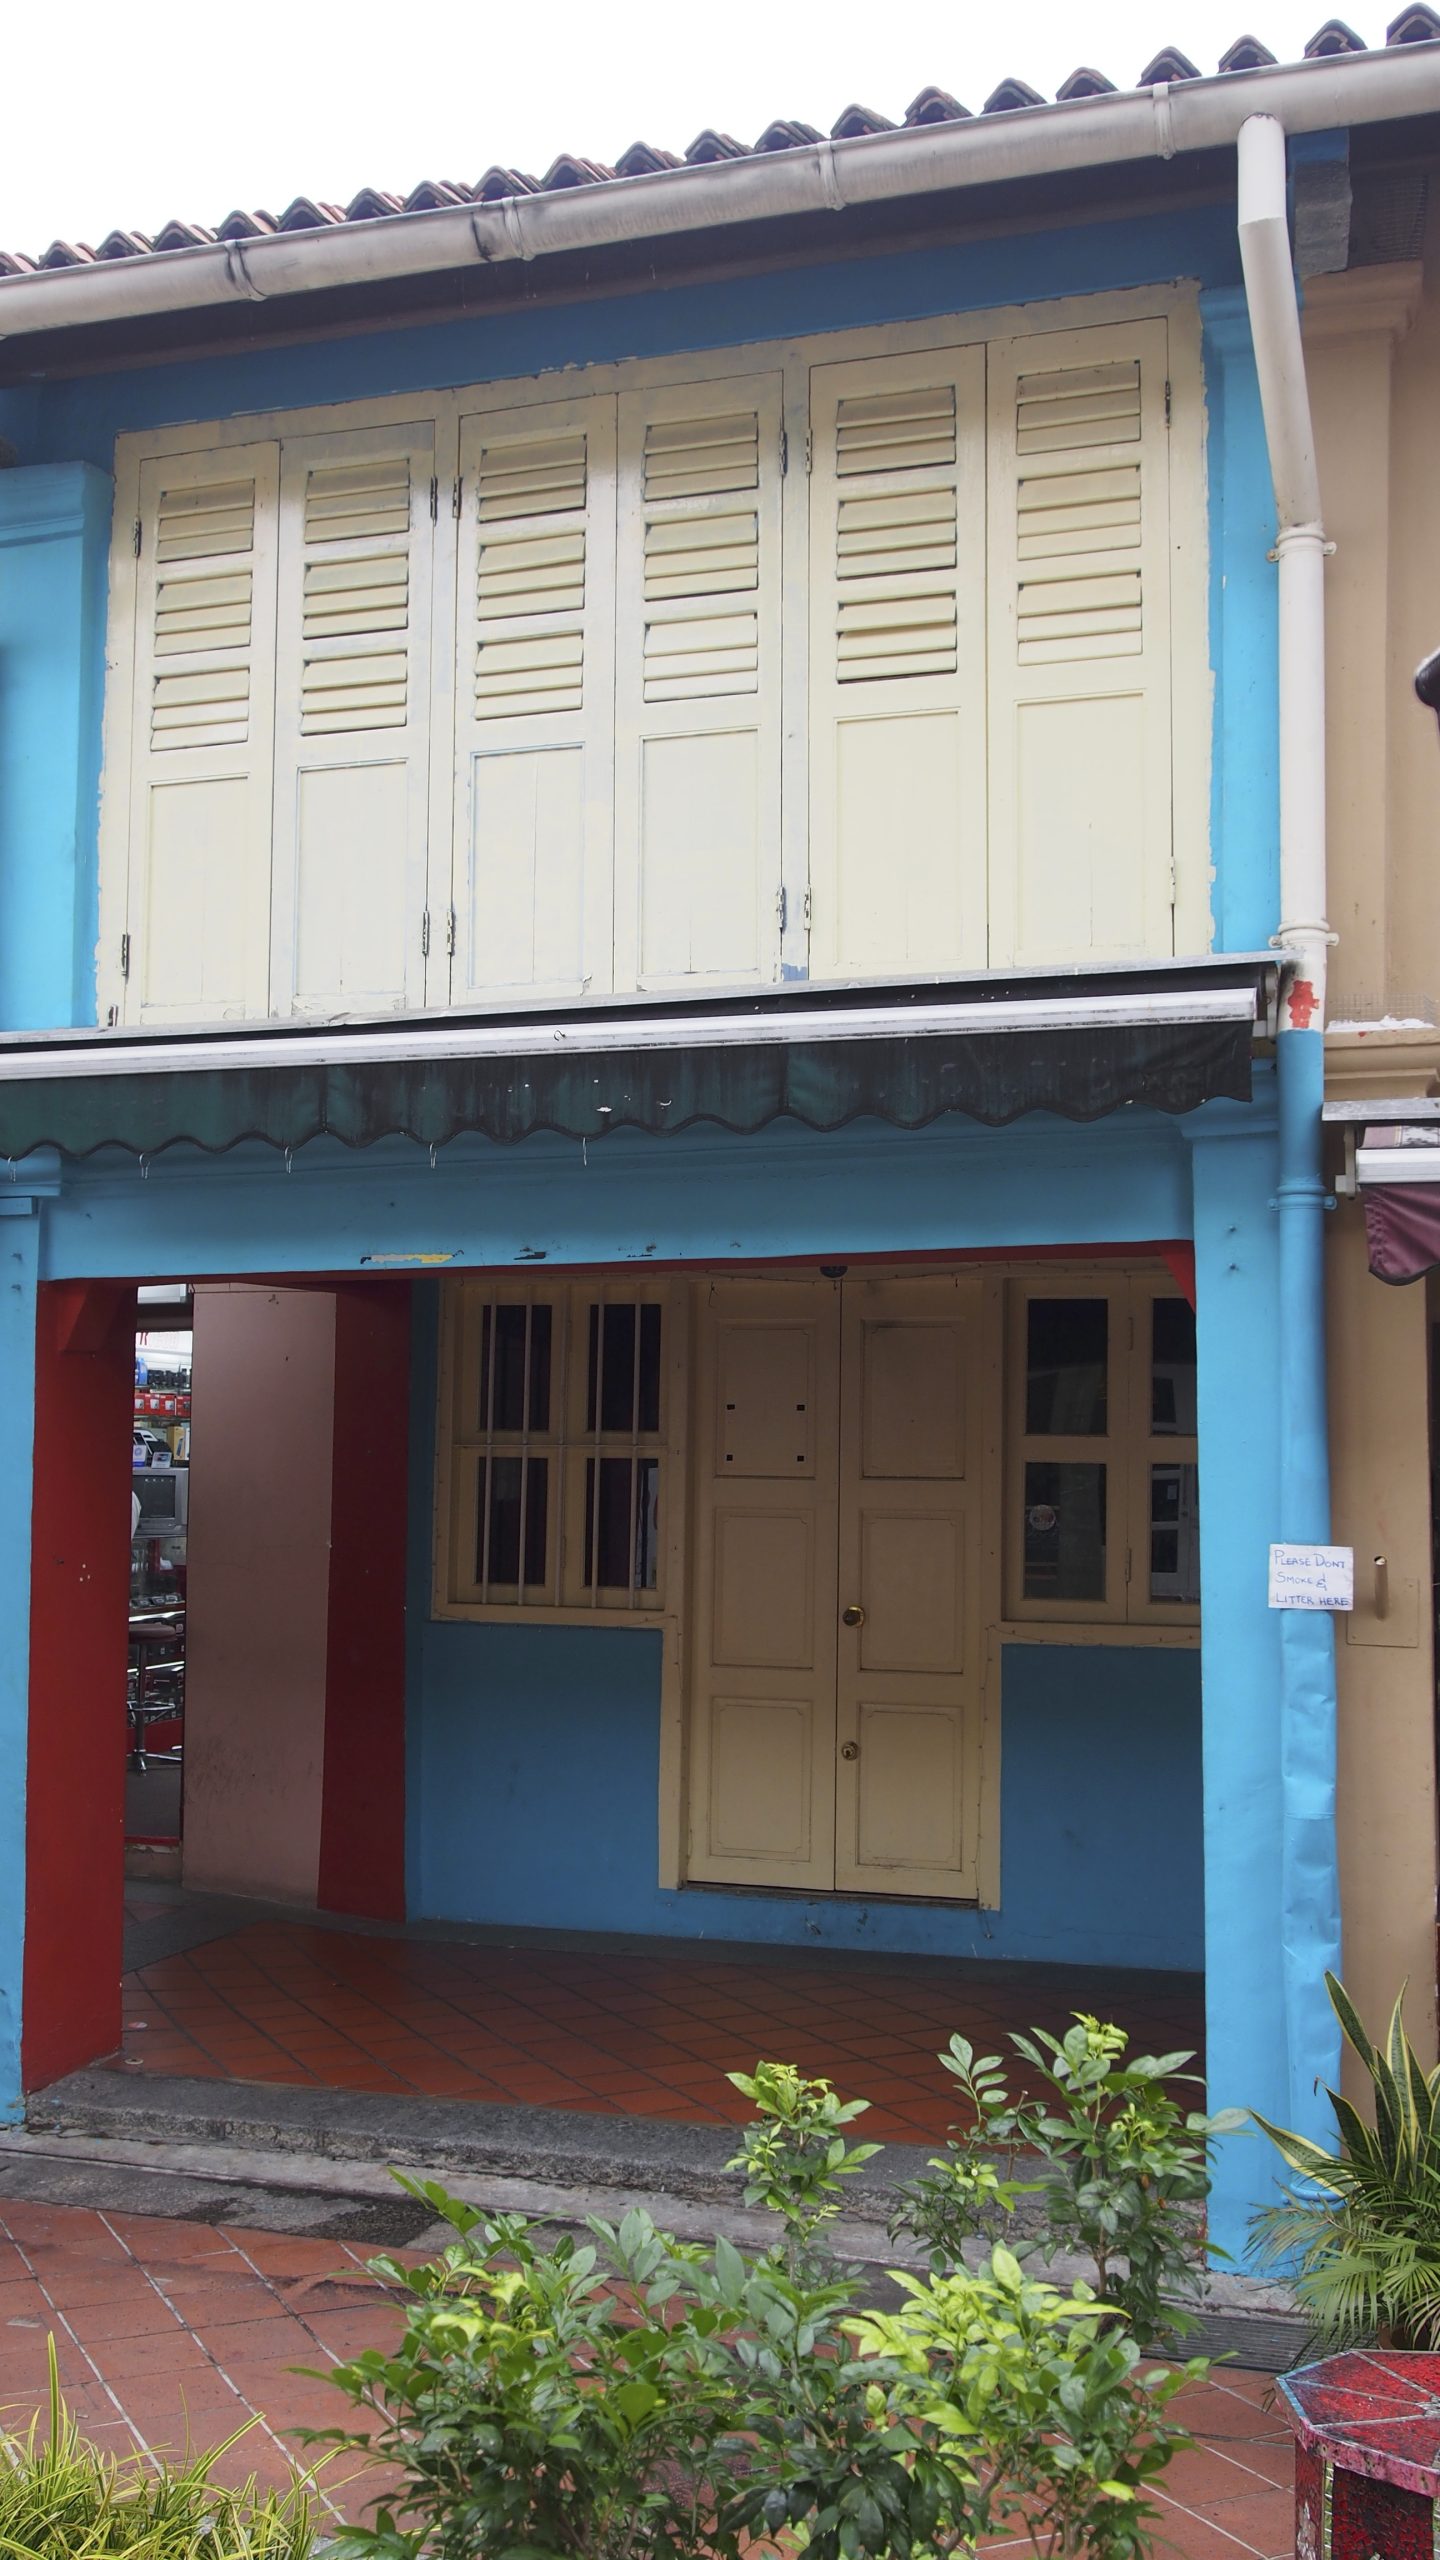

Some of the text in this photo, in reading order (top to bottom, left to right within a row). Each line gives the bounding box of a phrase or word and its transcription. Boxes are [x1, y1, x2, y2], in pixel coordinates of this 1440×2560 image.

[1274, 1549, 1312, 1566] PLEASE
[1275, 1571, 1313, 1584] SMOKE
[1276, 1592, 1349, 1606] LITTER HERE
